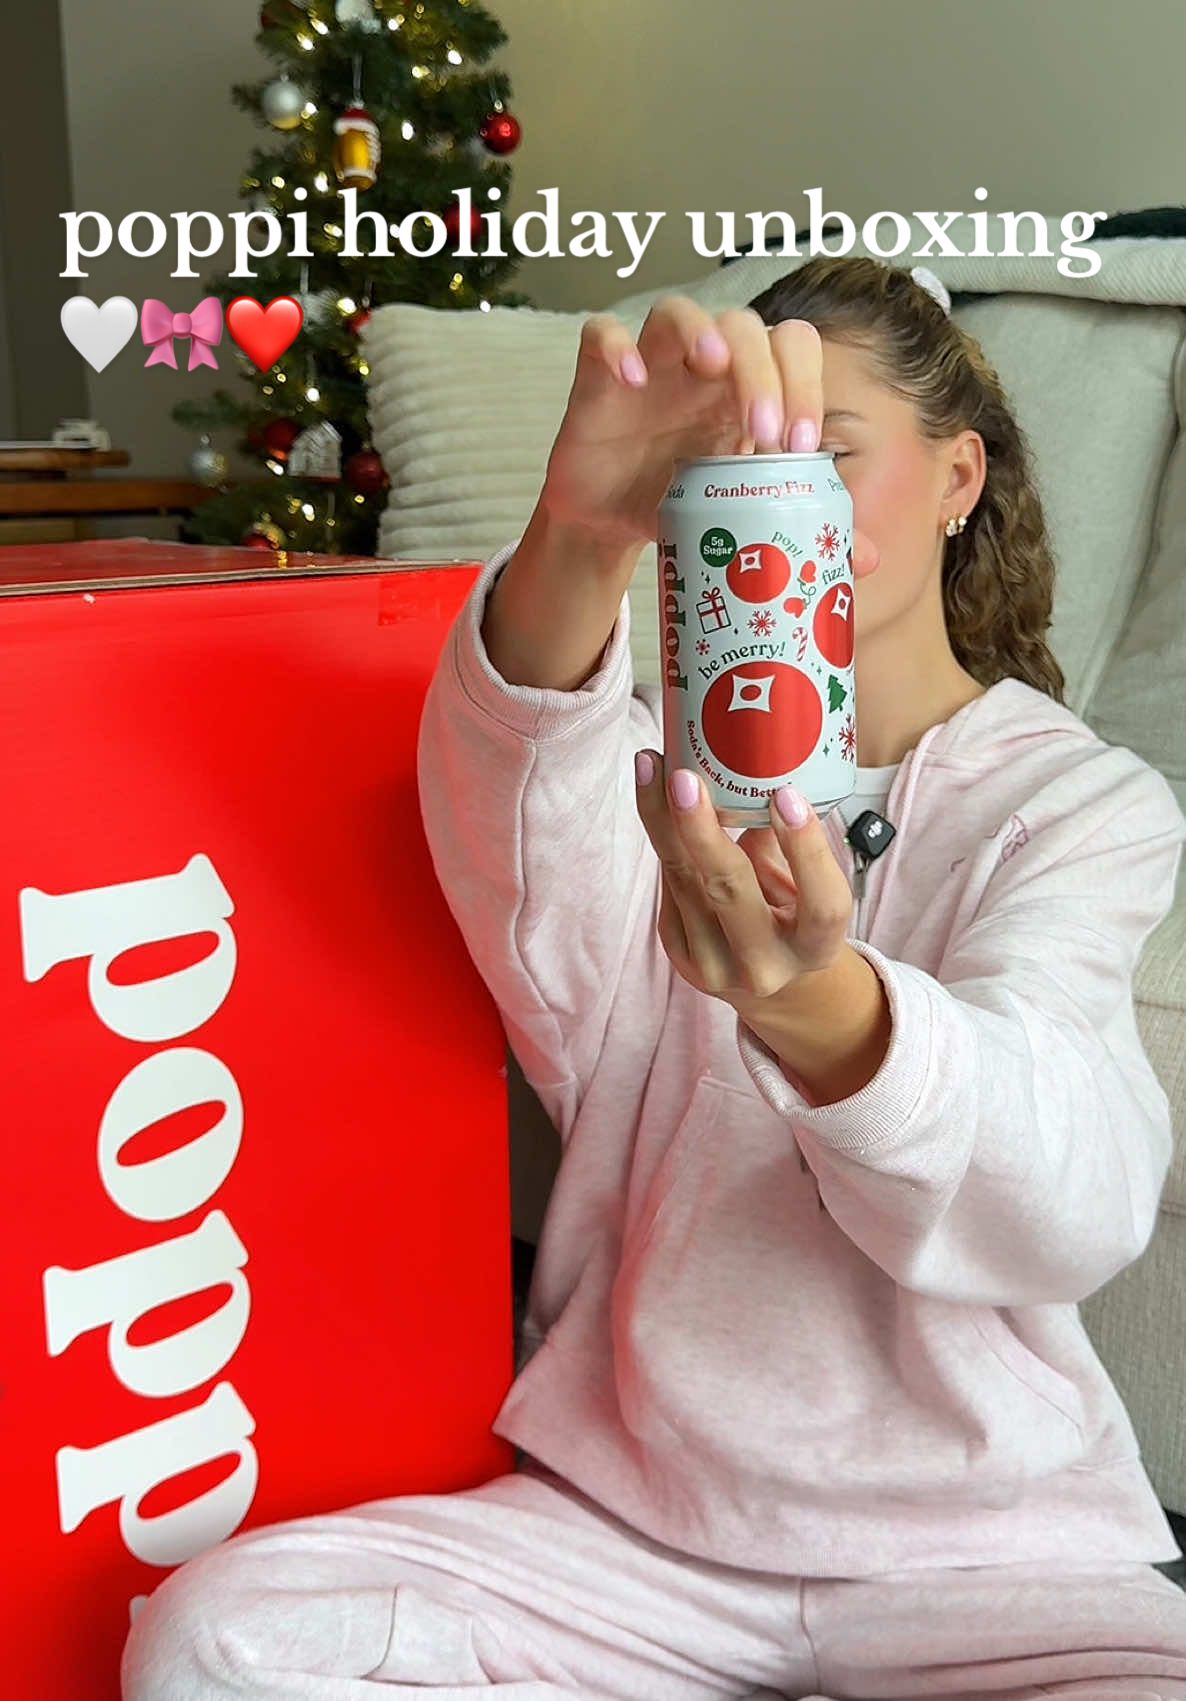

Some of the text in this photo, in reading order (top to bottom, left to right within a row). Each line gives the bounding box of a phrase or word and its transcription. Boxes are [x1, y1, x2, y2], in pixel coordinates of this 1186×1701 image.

[703, 482, 783, 499] Cranberry
[785, 480, 815, 497] Fizz
[703, 544, 734, 557] Sugar
[710, 536, 725, 547] 5g
[770, 531, 805, 558] pop!
[822, 564, 846, 586] fizz!
[659, 543, 688, 691] poppi
[698, 641, 787, 681] be merry!
[686, 719, 703, 759] Soda's
[699, 757, 727, 788] Back,
[726, 780, 750, 797] but
[20, 854, 258, 1625] popp
